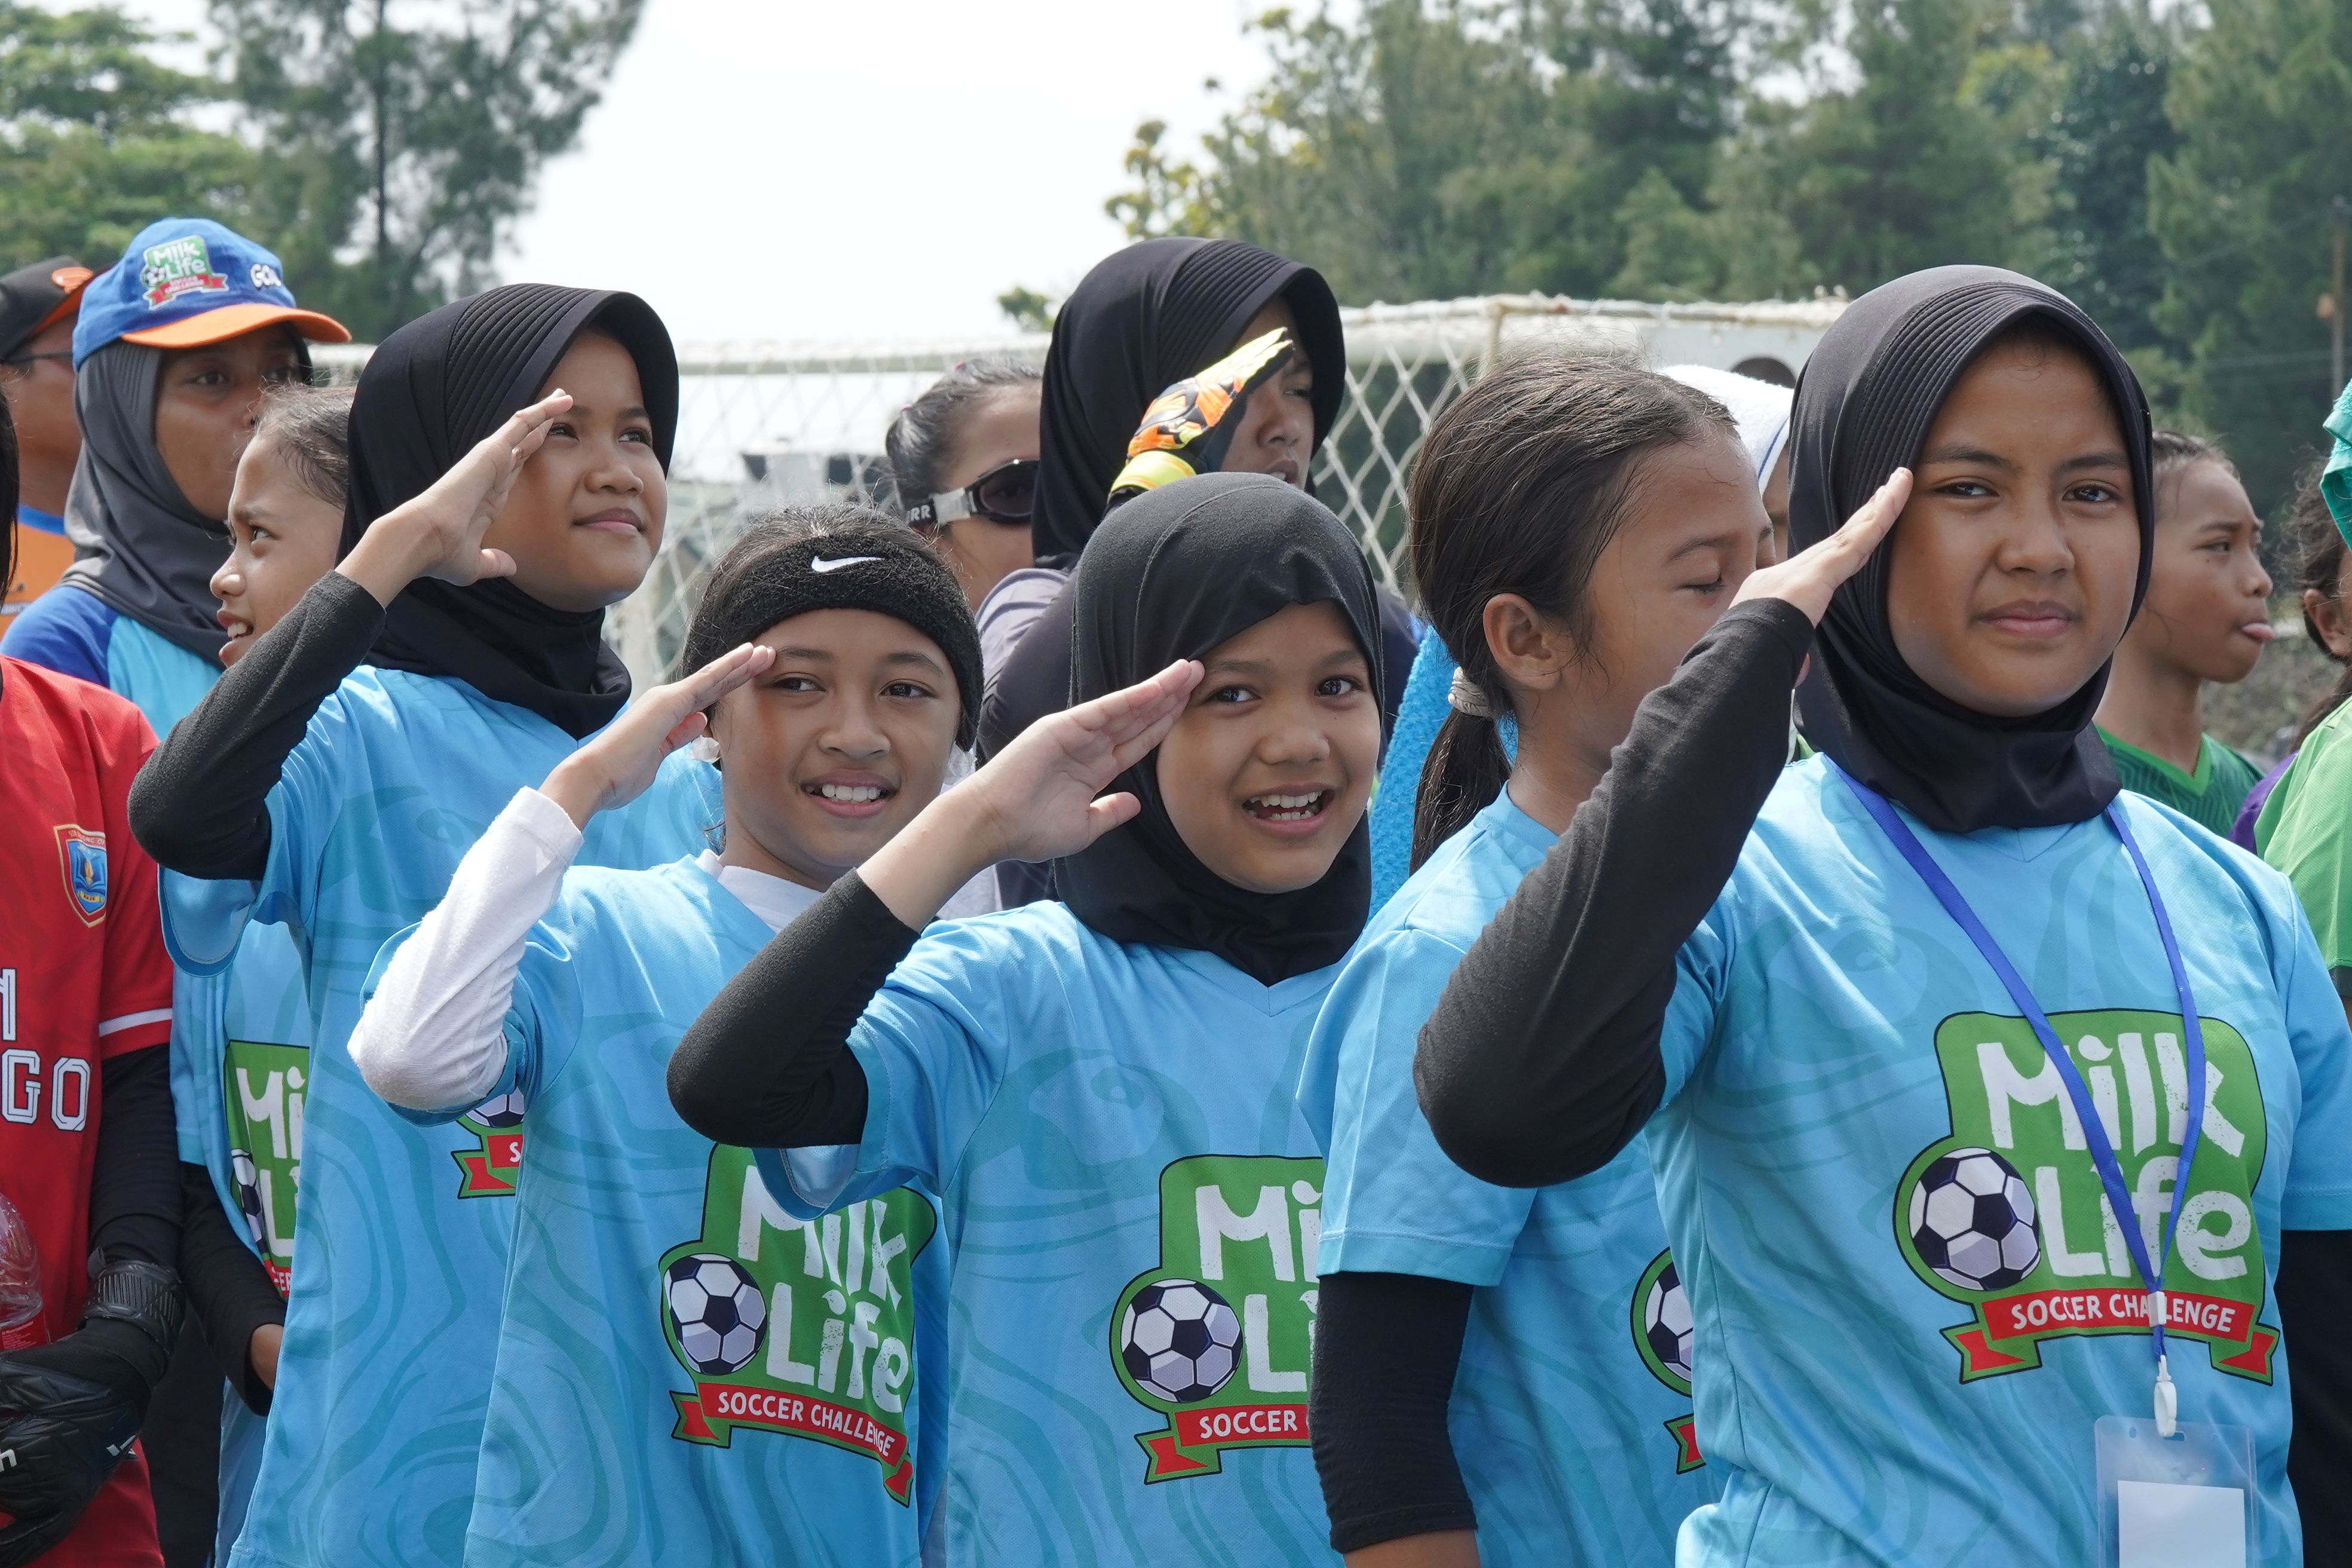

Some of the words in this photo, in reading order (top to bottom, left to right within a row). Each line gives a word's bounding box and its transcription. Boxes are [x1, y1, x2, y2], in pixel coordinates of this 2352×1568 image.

[152, 242, 201, 266] Milk
[164, 256, 206, 279] Life
[1977, 1033, 2245, 1157] Milk
[738, 1165, 907, 1312] Milk
[2035, 1156, 2251, 1280] Life
[2011, 1294, 2103, 1330] SOCCER
[2109, 1293, 2235, 1332] CHALENGE
[766, 1282, 908, 1413] Life
[718, 1391, 804, 1422] SOCCER
[811, 1404, 895, 1457] CHALLENGE
[1199, 1410, 1298, 1439] SOCCER
